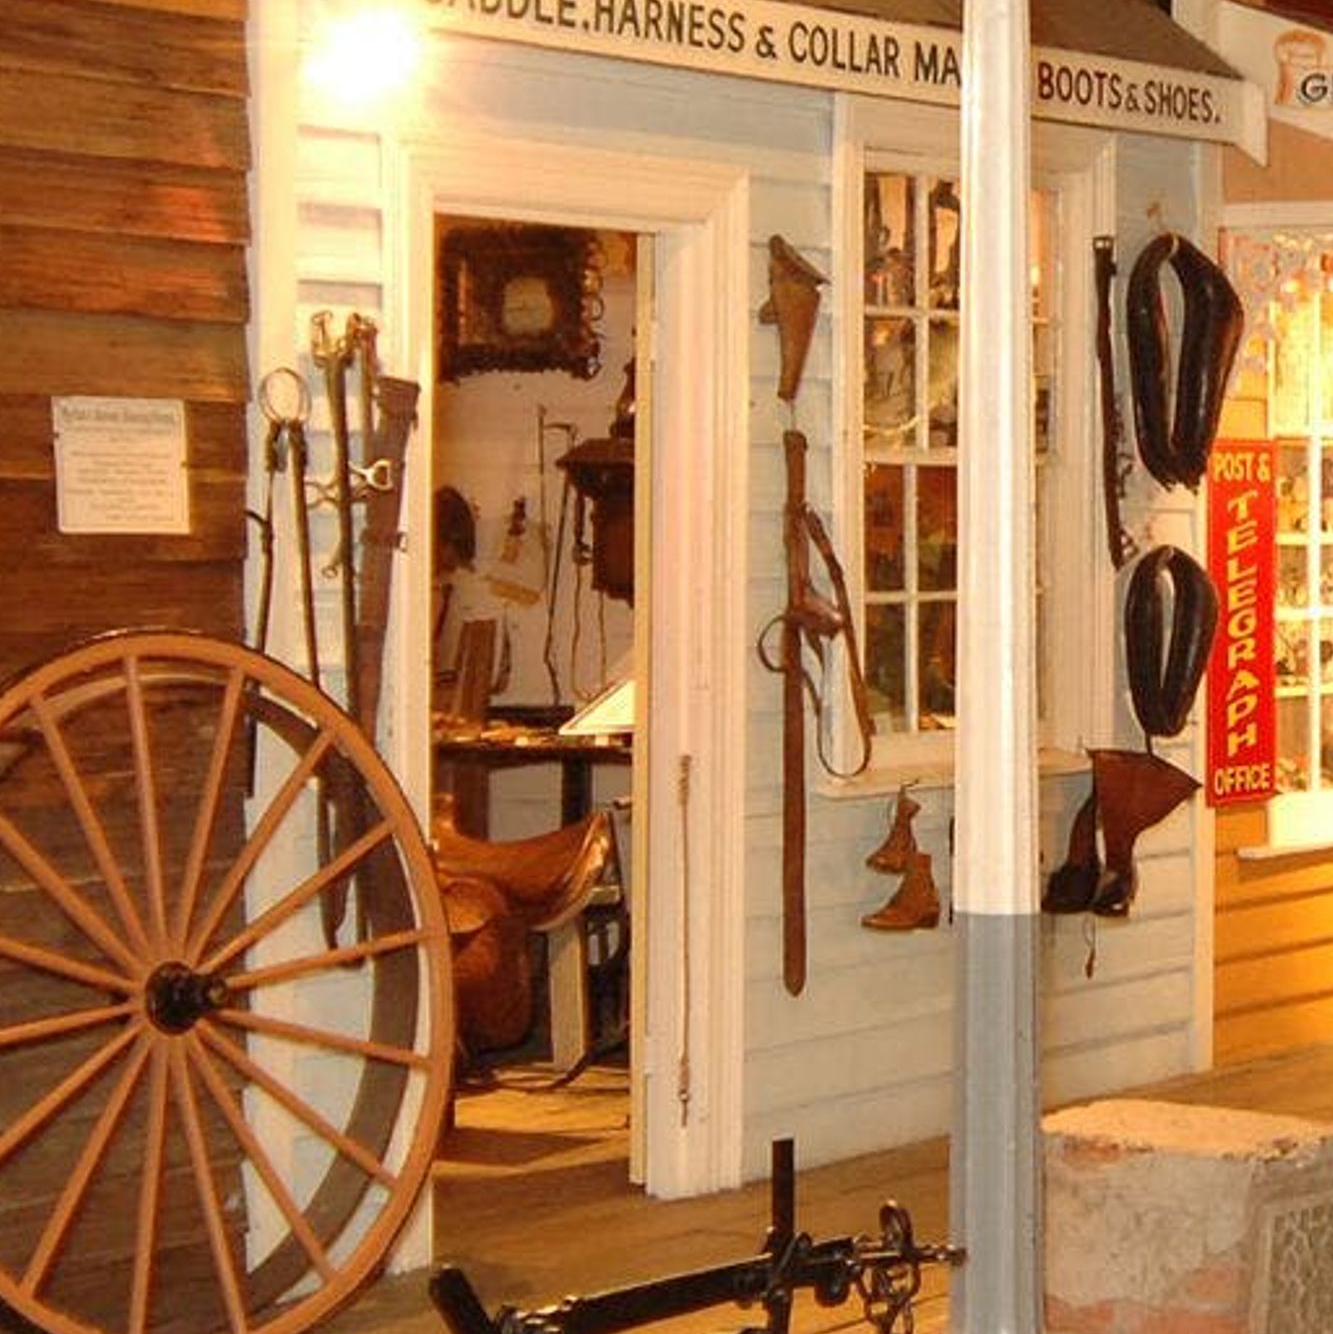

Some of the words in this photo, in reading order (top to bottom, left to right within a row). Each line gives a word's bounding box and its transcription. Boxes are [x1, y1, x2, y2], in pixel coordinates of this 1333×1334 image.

[755, 25, 777, 60] &
[788, 21, 901, 79] COLLAR
[1212, 452, 1254, 483] POST
[1257, 453, 1272, 483] &
[1226, 489, 1260, 757] TELEGRAPH
[1213, 763, 1272, 797] OFFICE
